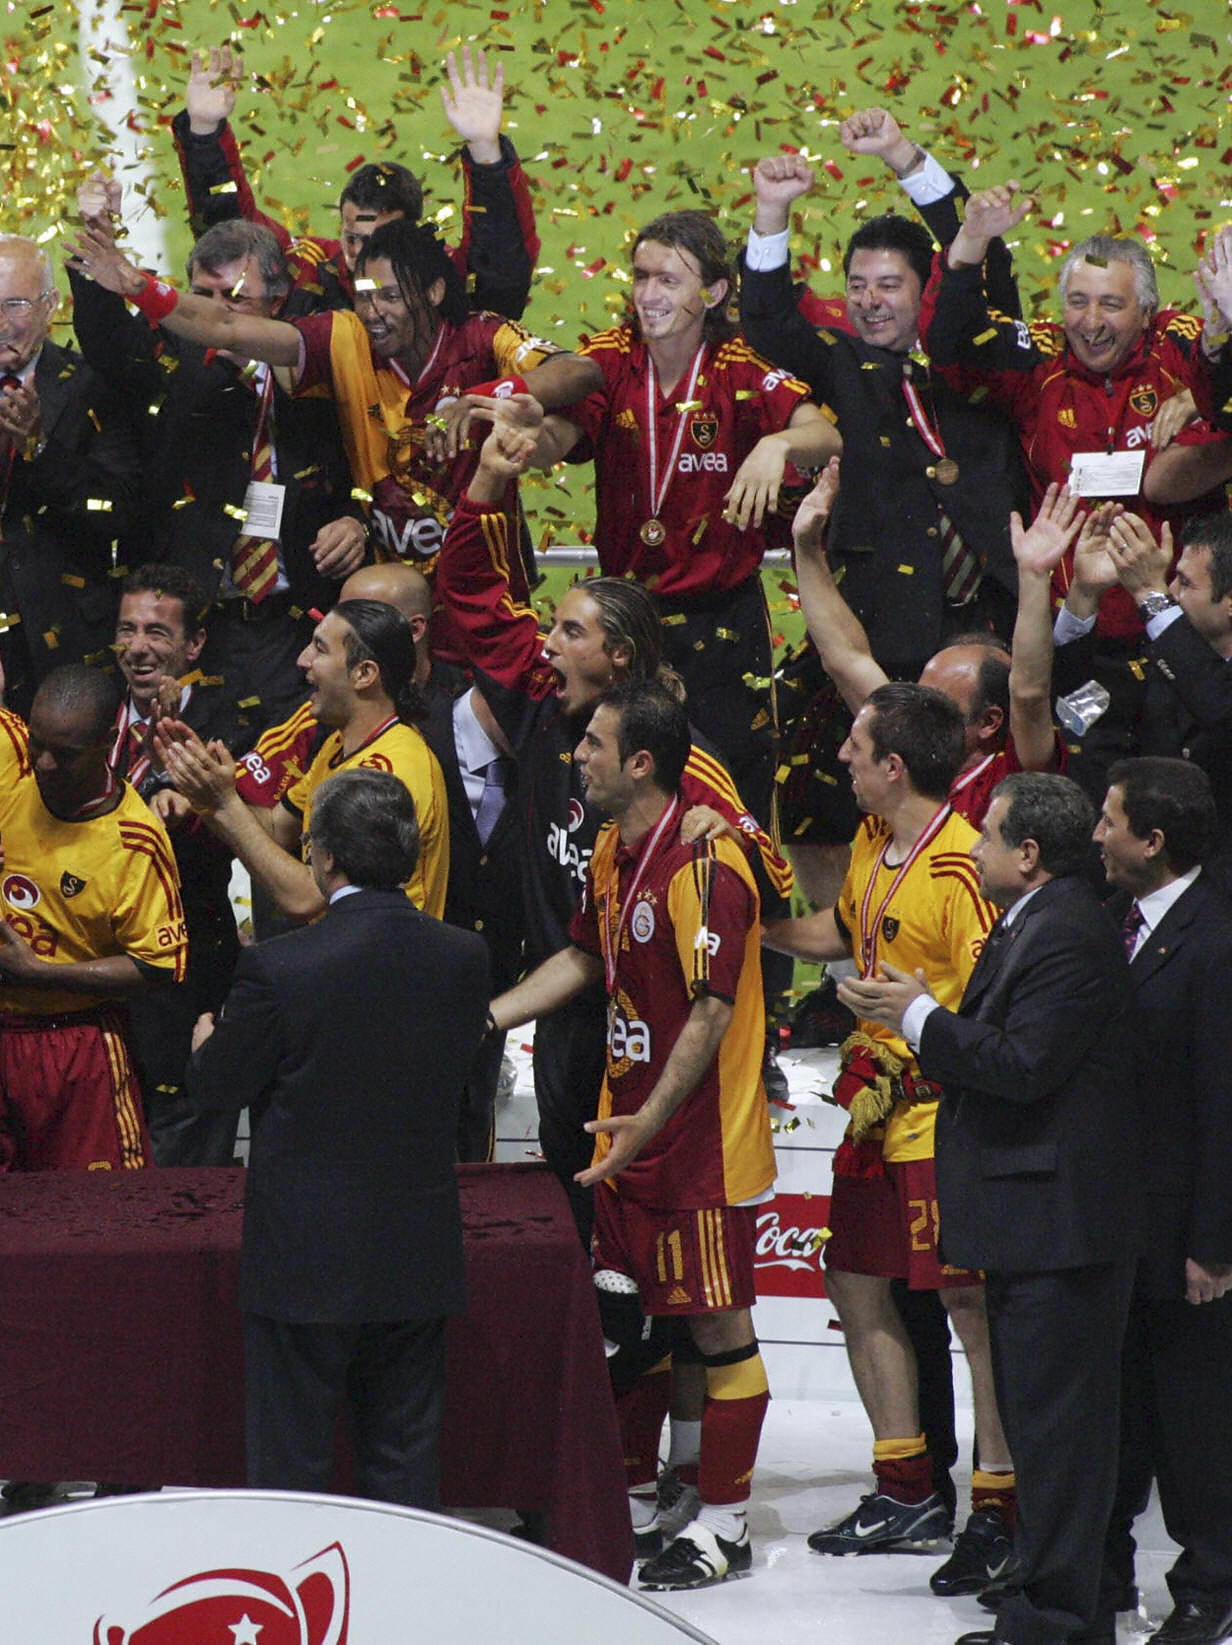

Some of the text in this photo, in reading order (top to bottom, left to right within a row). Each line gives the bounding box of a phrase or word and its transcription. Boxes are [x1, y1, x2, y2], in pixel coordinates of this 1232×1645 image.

[1126, 421, 1154, 448] av
[678, 452, 728, 472] avea
[656, 1229, 683, 1282] 11
